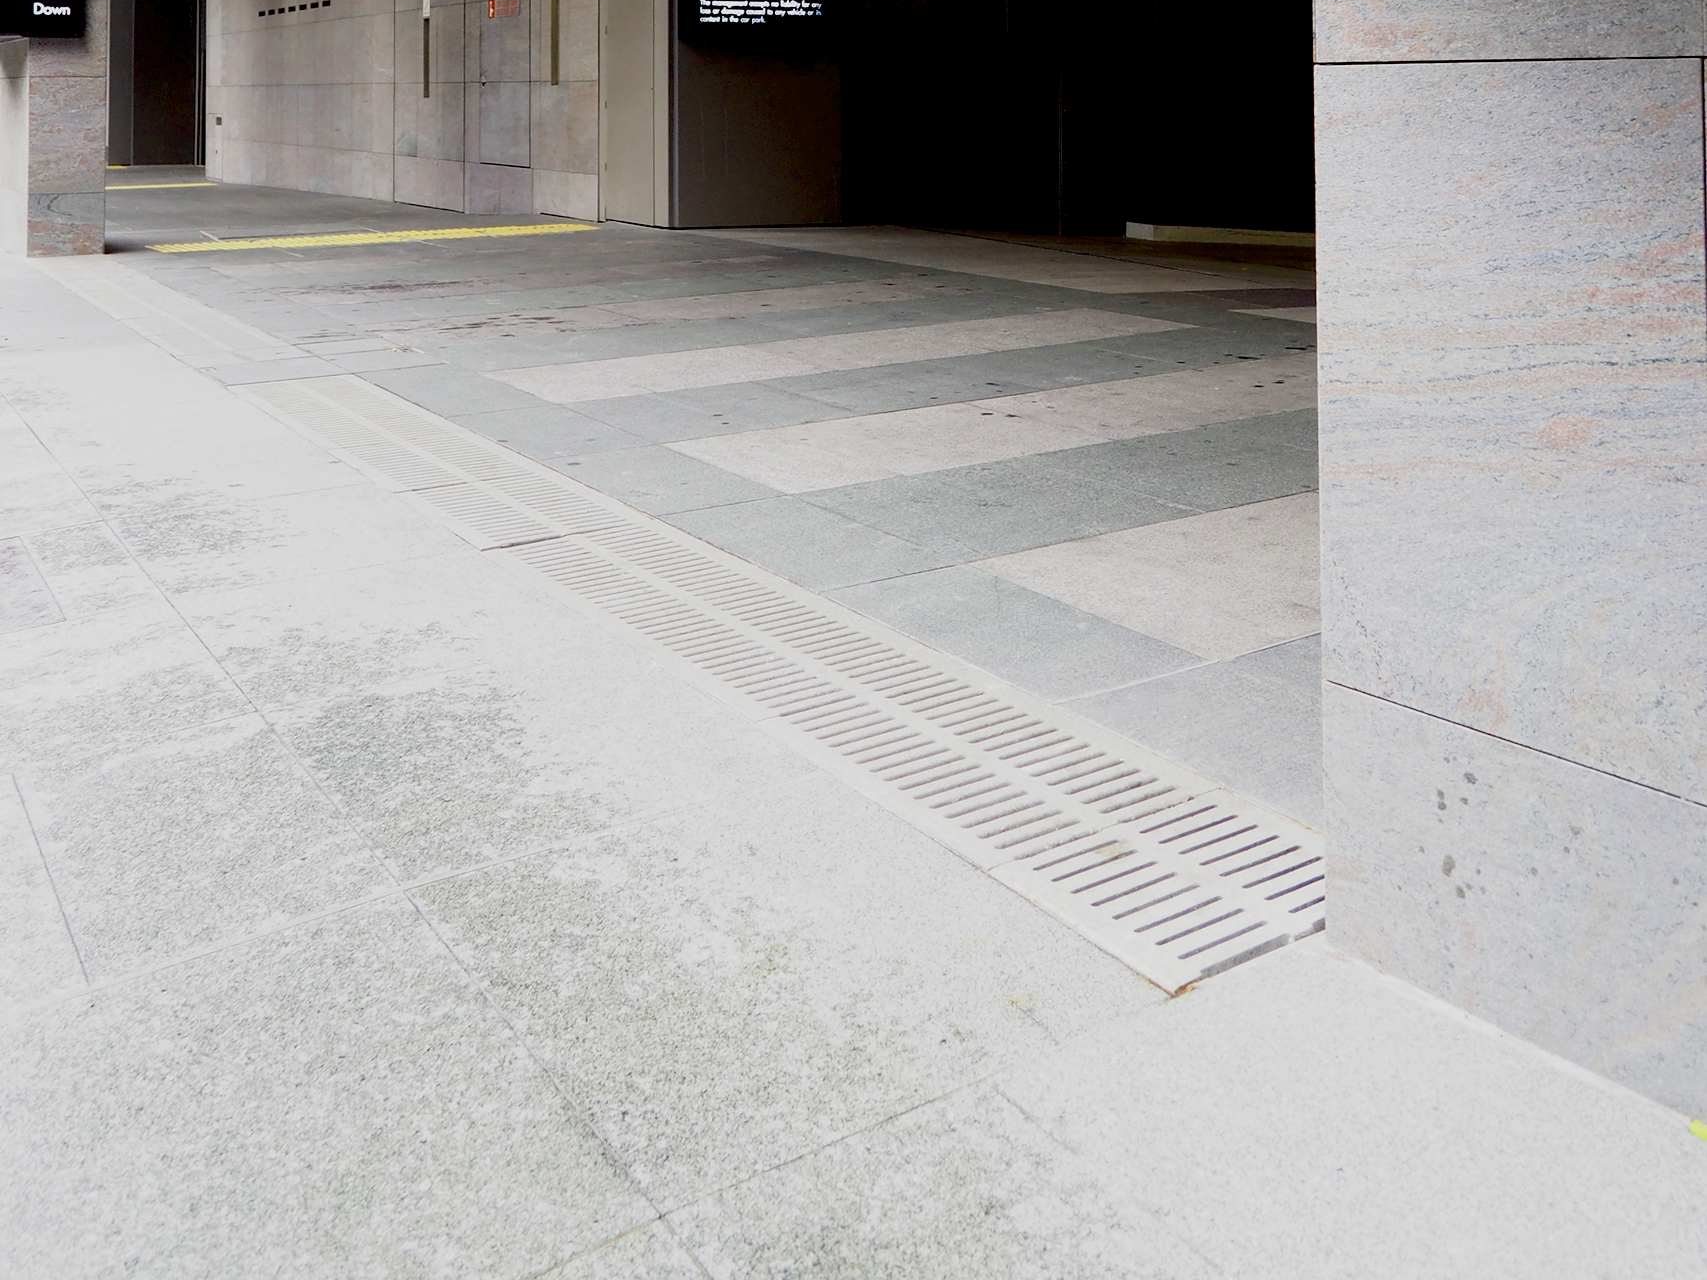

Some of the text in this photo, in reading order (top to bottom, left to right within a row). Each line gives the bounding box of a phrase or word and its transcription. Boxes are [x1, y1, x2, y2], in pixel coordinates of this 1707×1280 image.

[712, 0, 748, 8] management
[780, 0, 800, 8] liability
[801, 0, 810, 8] for
[33, 2, 71, 16] Down
[721, 7, 744, 16] damage
